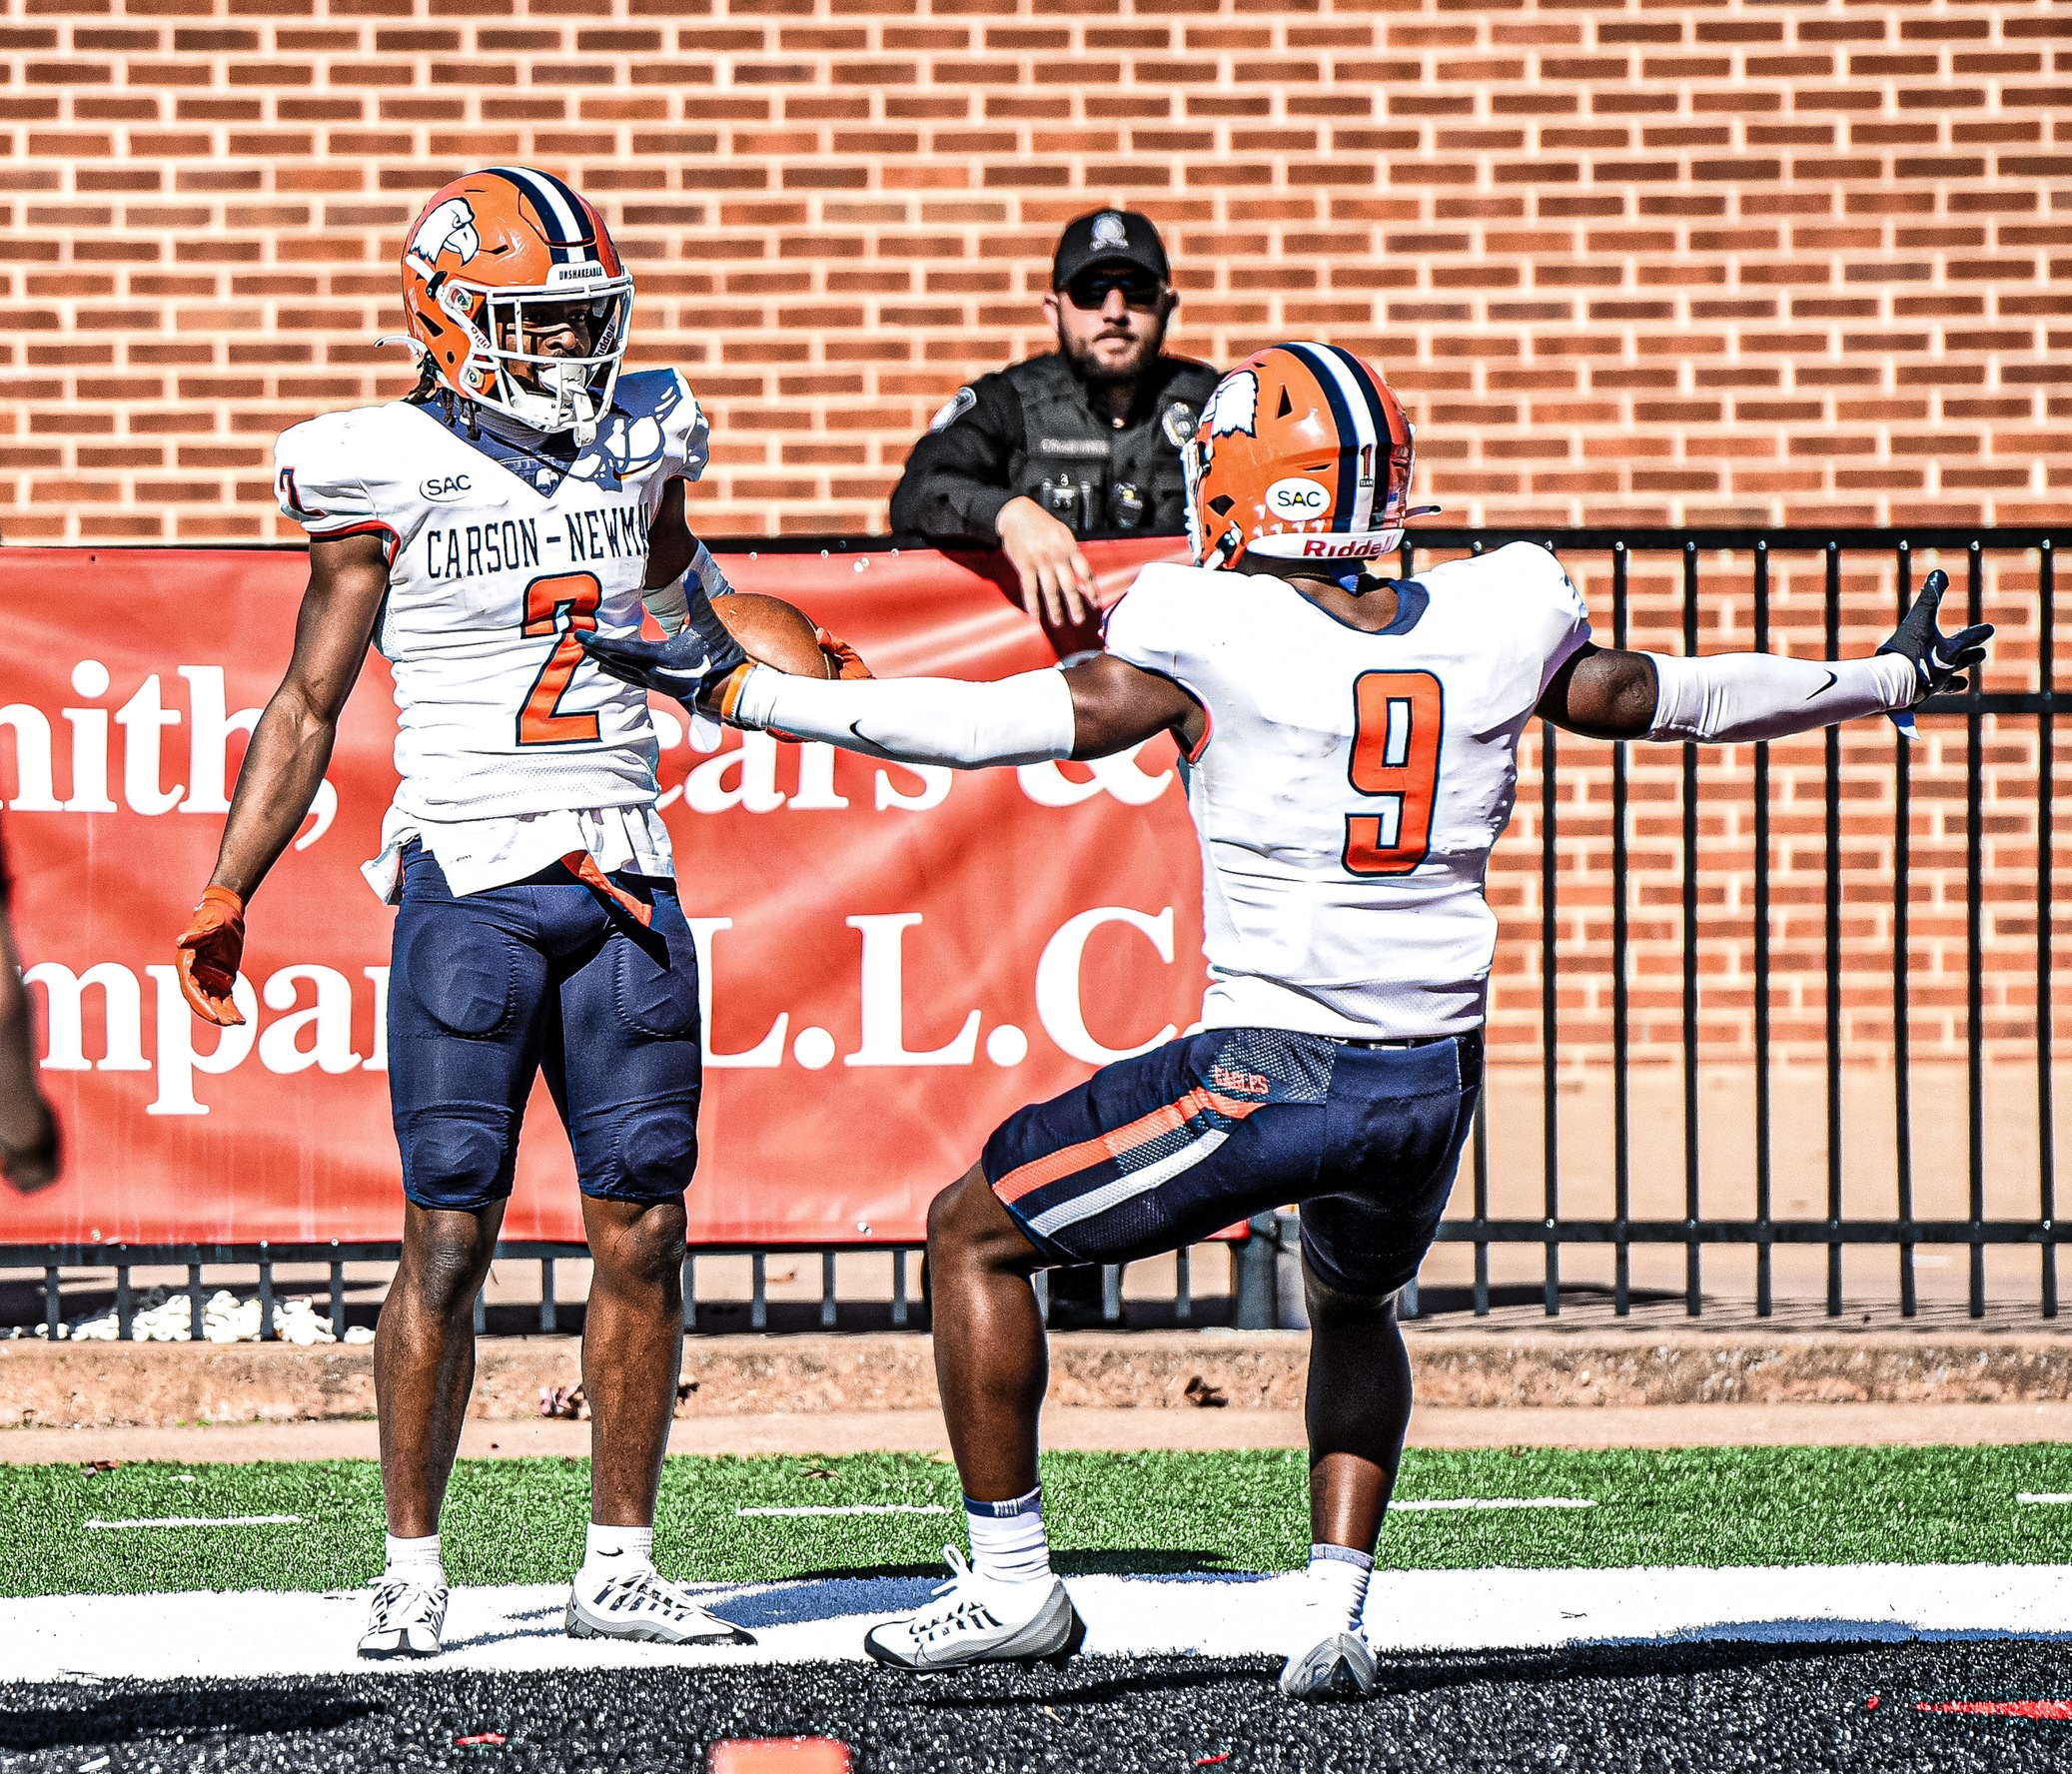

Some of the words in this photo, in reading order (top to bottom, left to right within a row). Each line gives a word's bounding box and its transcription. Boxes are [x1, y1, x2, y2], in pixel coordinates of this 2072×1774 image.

[558, 266, 603, 281] UNSHAKEABLE
[426, 473, 473, 496] SAC
[1277, 489, 1322, 507] SAC
[1302, 533, 1398, 557] Riddell
[515, 569, 603, 748] 2
[1341, 667, 1446, 878] 9
[1213, 1063, 1270, 1096] EAGLES
